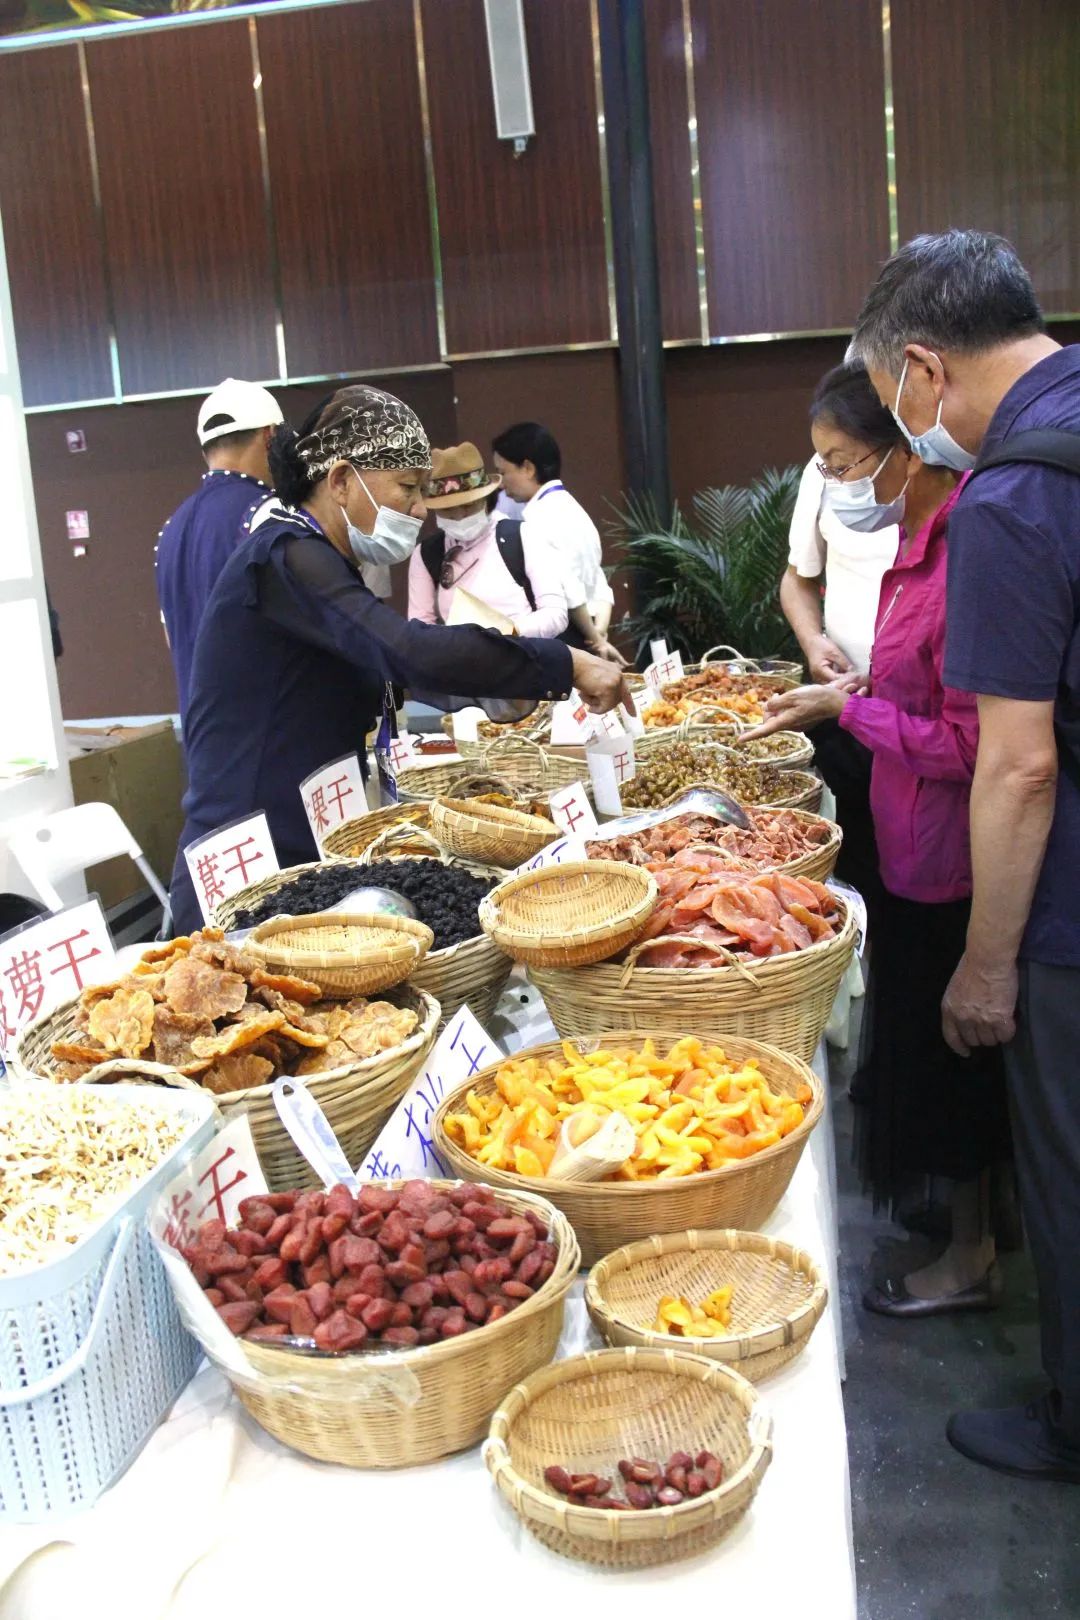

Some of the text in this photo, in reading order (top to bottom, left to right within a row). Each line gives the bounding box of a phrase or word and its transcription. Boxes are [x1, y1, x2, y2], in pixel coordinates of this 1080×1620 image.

[614, 751, 630, 780] 干
[304, 774, 353, 836] 果干
[560, 798, 585, 833] 干
